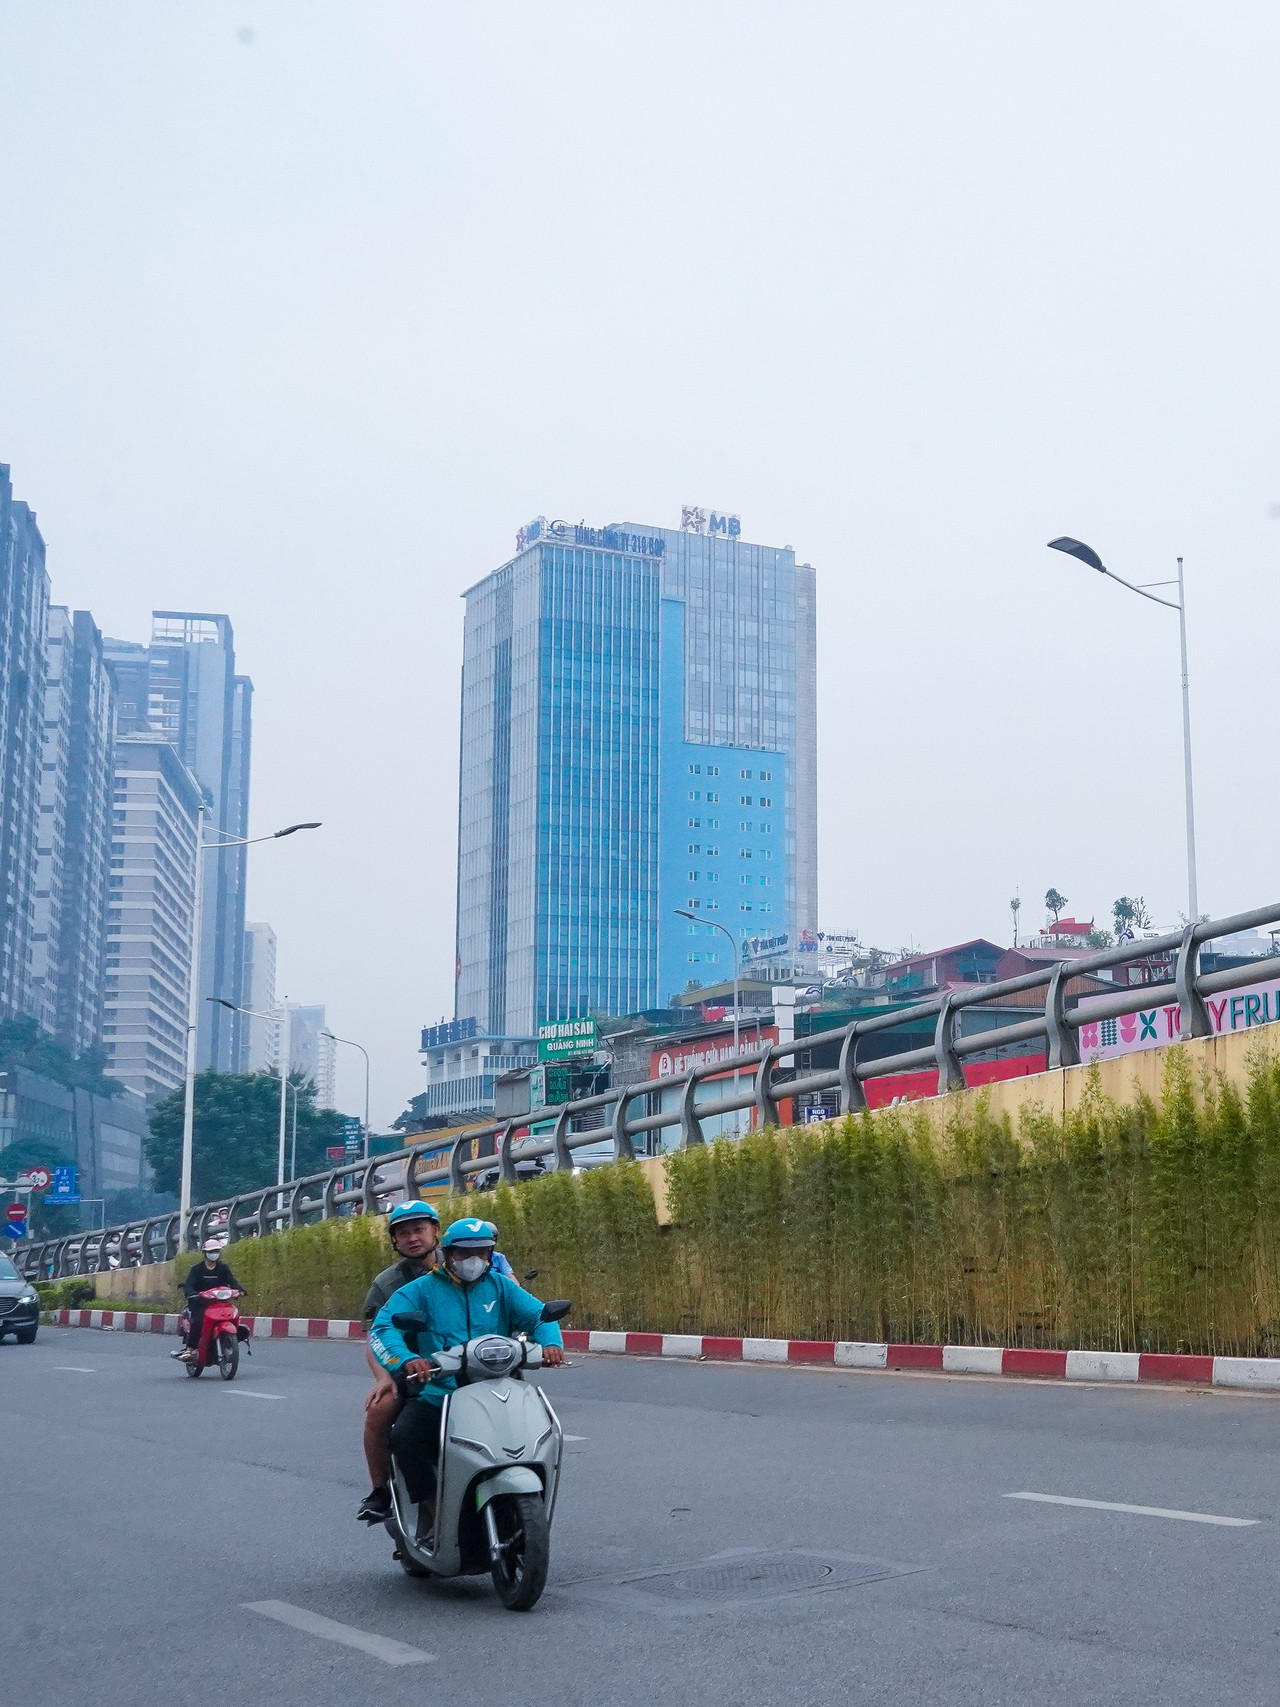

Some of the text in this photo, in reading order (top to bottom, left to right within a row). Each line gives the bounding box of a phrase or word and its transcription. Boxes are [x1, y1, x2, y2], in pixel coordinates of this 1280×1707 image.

[709, 513, 741, 536] MB
[574, 1017, 594, 1036] SẢN
[576, 1038, 594, 1048] NINH
